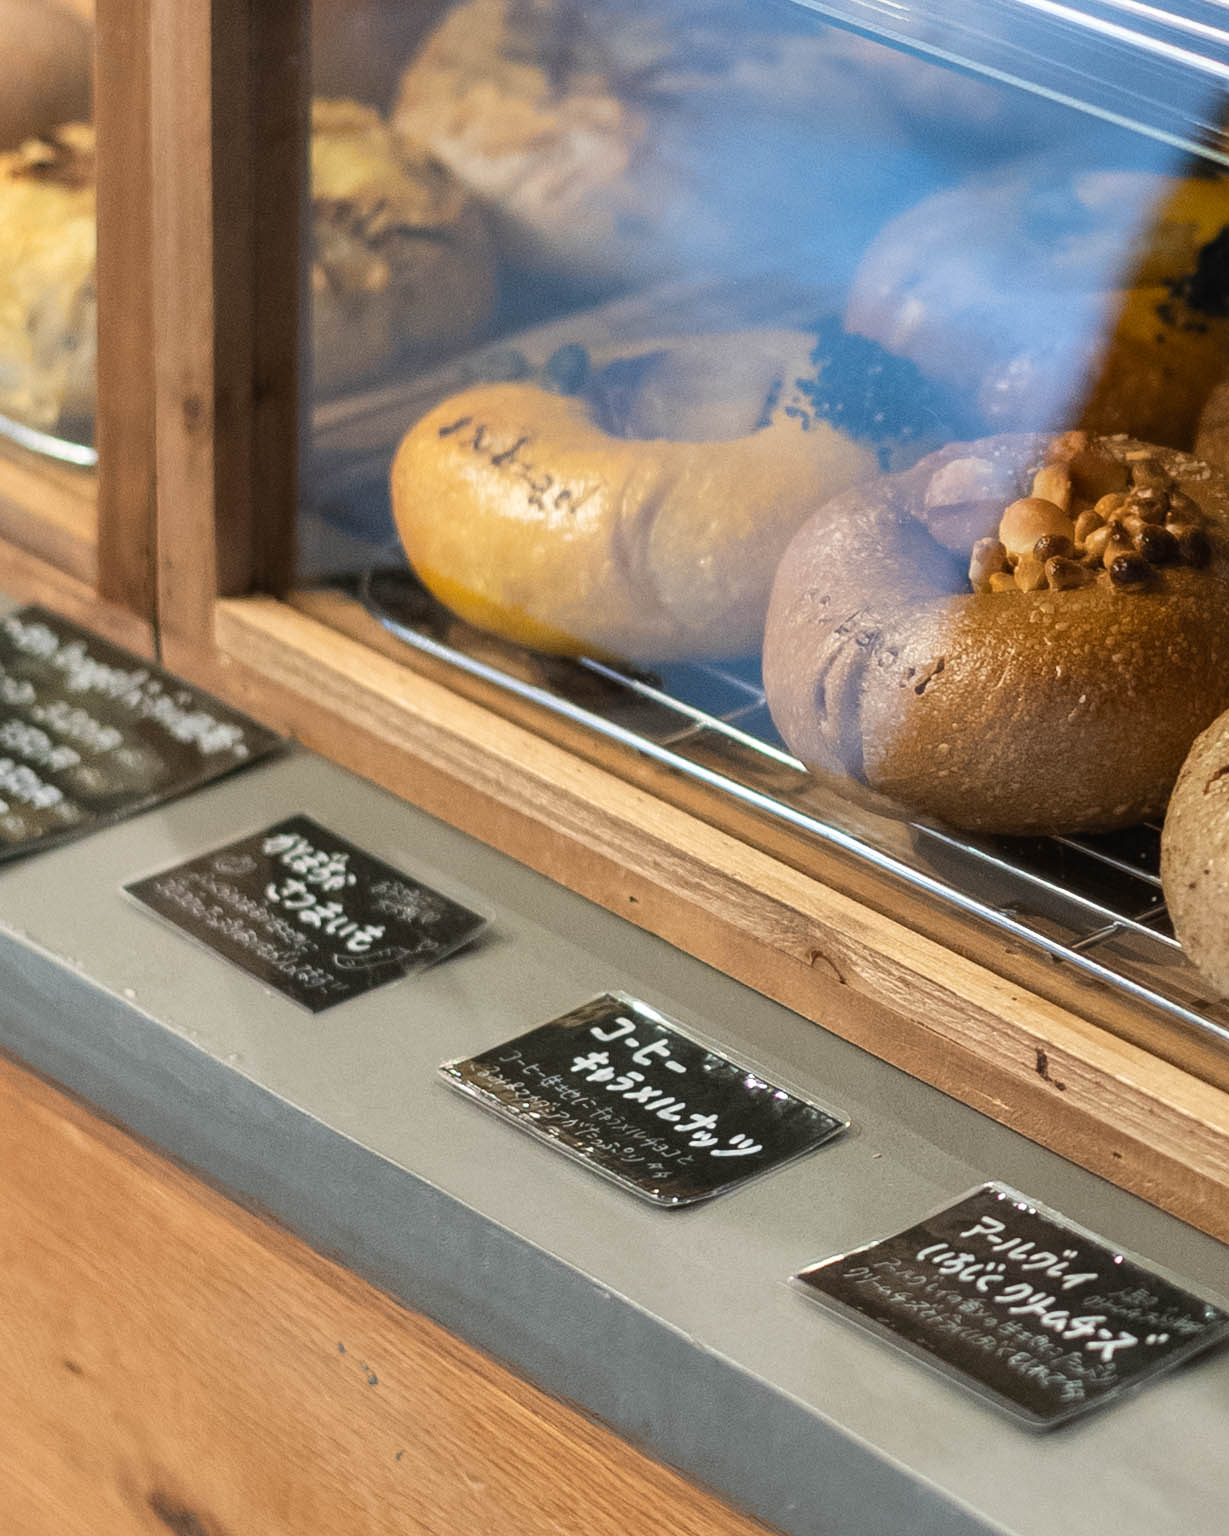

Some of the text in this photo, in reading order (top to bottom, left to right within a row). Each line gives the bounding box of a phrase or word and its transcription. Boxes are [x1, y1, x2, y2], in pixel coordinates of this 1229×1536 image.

[264, 877, 386, 951] さつまいも
[590, 1016, 687, 1074] コーヒー
[570, 1050, 763, 1157] キャラメルナッツ
[960, 1215, 1099, 1290] アールグレイ
